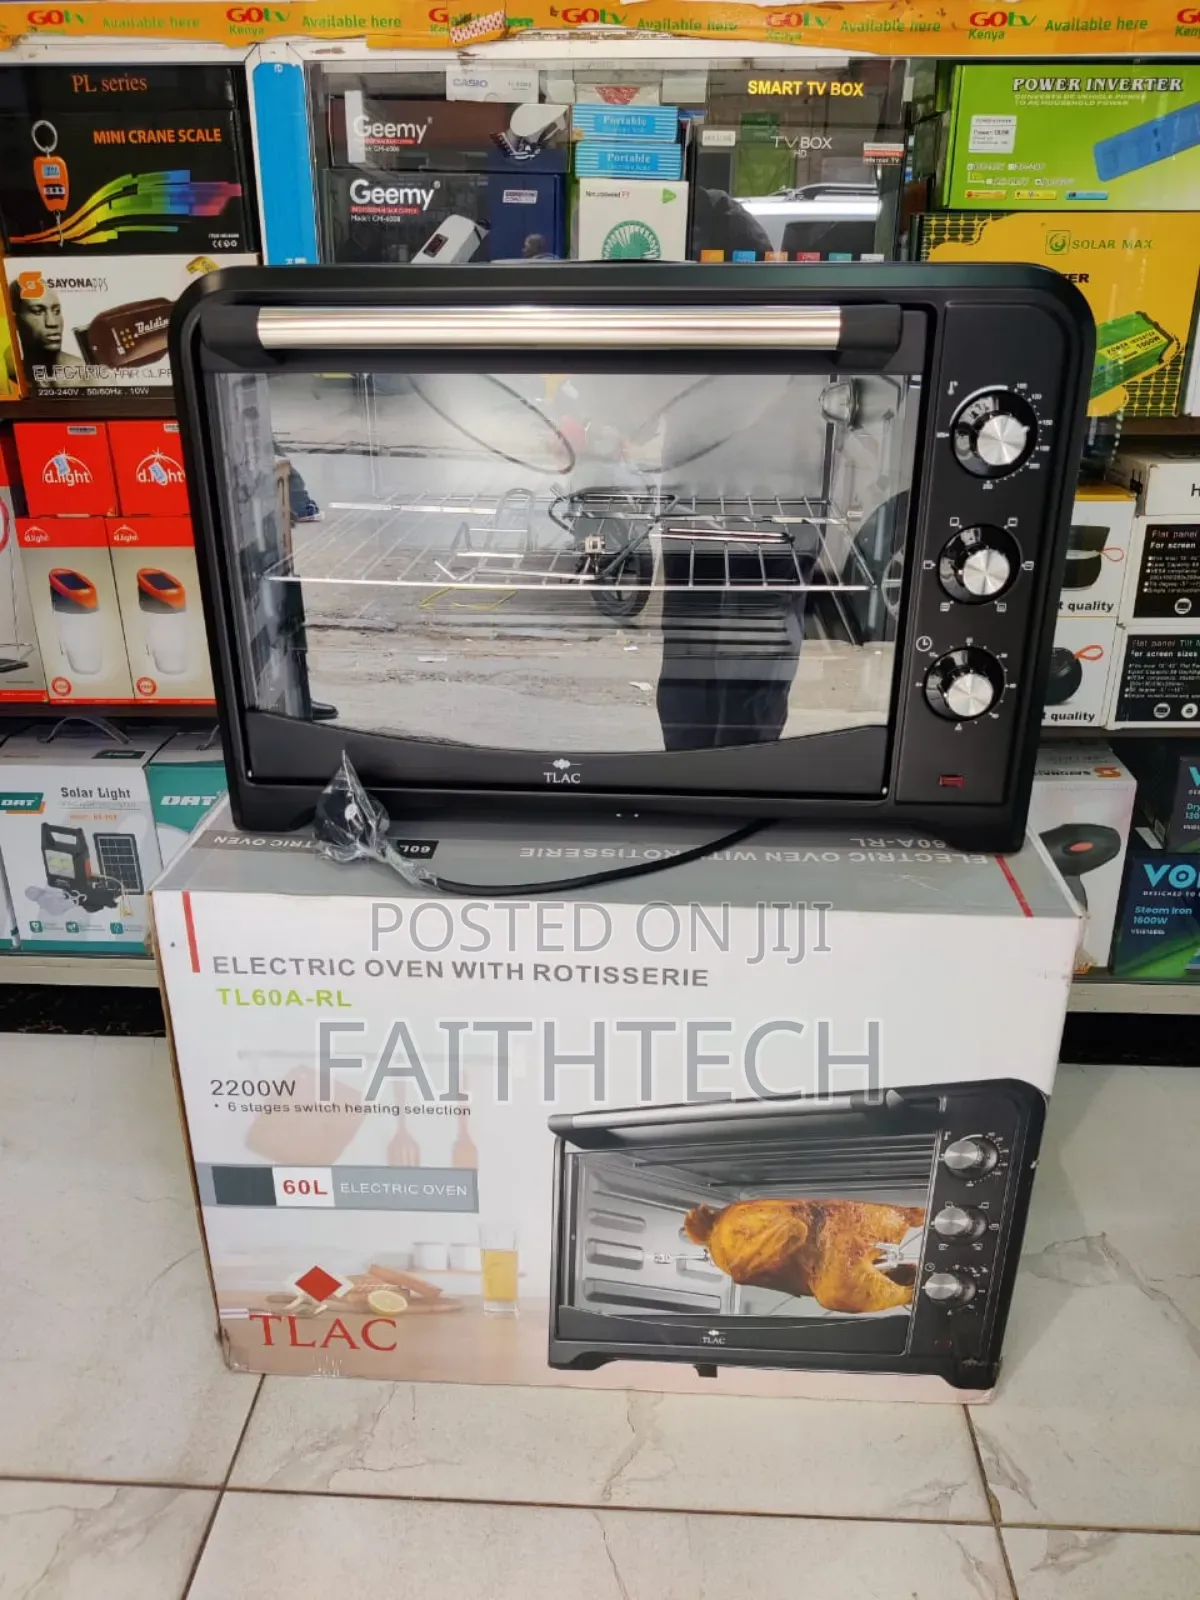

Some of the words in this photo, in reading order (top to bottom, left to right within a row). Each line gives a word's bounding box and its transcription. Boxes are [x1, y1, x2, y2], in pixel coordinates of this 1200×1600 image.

[103, 15, 165, 29] Available
[170, 16, 199, 28] here
[226, 6, 291, 23] GOtv
[302, 14, 366, 29] Available
[371, 15, 401, 28] here
[562, 8, 628, 24] GOtv
[637, 18, 701, 31] Available
[707, 19, 738, 32] here
[766, 11, 832, 27] GOtv
[840, 20, 904, 32] Available
[910, 22, 941, 32] here
[969, 11, 1037, 27] GOtv
[1045, 17, 1112, 31] Available
[1117, 17, 1148, 30] here
[229, 24, 265, 36] Kenya
[968, 28, 1005, 40] Kenya
[72, 75, 97, 93] PL
[102, 73, 147, 92] series
[453, 78, 488, 88] CASIO
[747, 80, 802, 96] SMART
[806, 81, 827, 96] TV
[830, 81, 864, 97] BOX
[1012, 77, 1081, 92] POWER
[1086, 77, 1183, 92] INVERTER
[603, 115, 647, 126] Portable
[93, 130, 126, 145] MINI
[128, 129, 176, 144] CRANE
[178, 128, 222, 143] SCALE
[354, 115, 427, 144] Geemy
[801, 136, 832, 149] BOX
[608, 153, 651, 163] Portable
[350, 178, 435, 211] Geemy
[1071, 240, 1116, 249] SOLAR
[1121, 239, 1152, 249] MAX
[46, 278, 93, 289] SAYONA
[32, 365, 109, 381] ELECTRIC
[1067, 601, 1114, 613] quality
[1050, 712, 1095, 722] quality
[543, 772, 581, 784] TLAC
[61, 787, 93, 798] Solar
[97, 787, 131, 800] Light
[764, 851, 840, 863] OVEN
[1135, 906, 1170, 915] Steam
[1133, 916, 1168, 925] 1600W
[213, 956, 356, 977] ELECTRIC
[365, 959, 444, 979] OVEN
[452, 961, 524, 981] WITH
[533, 963, 709, 987] ROTISSERIE
[216, 988, 352, 1008] TL60A-RL
[210, 1079, 296, 1097] 2200W
[228, 1101, 237, 1112] 6
[241, 1102, 290, 1115] stages
[294, 1102, 341, 1114] switch
[345, 1103, 399, 1116] heating
[404, 1105, 471, 1116] selection
[283, 1179, 328, 1196] 60L
[340, 1182, 419, 1195] ELECTRIC
[423, 1183, 468, 1197] OVEN
[250, 1313, 398, 1352] TLAC
[702, 1336, 726, 1345] TLAC
